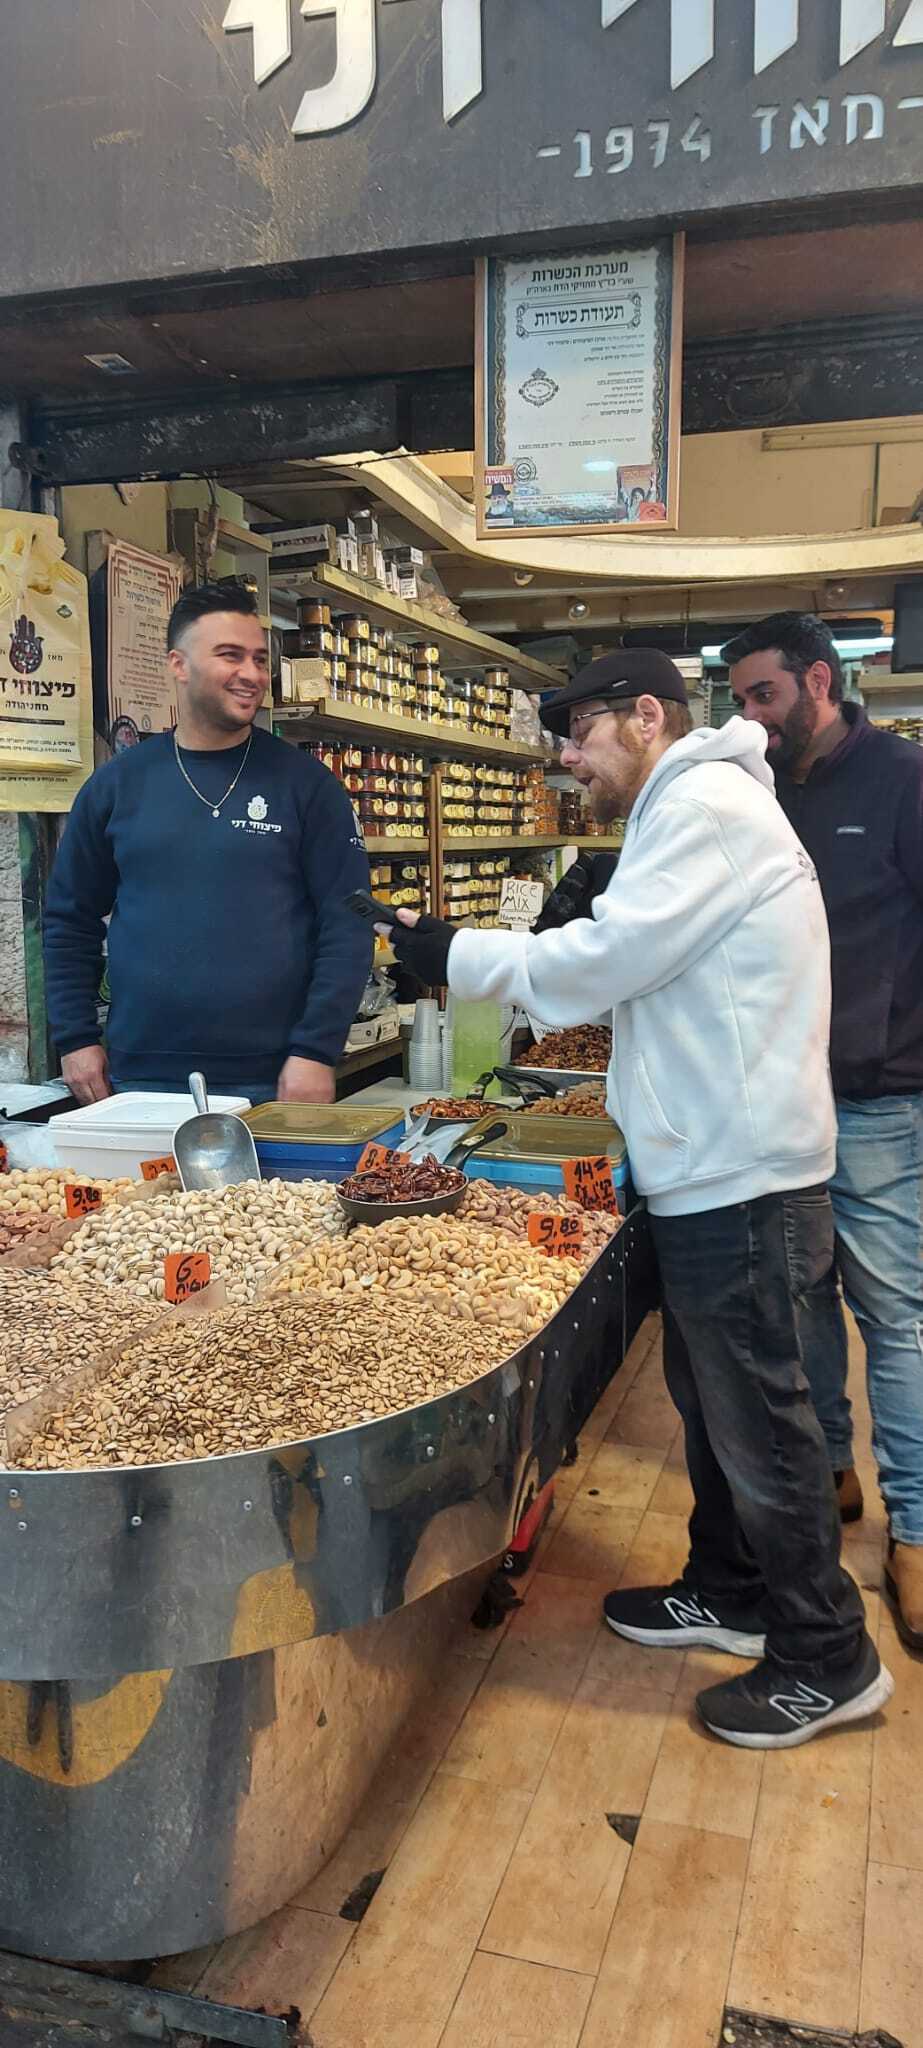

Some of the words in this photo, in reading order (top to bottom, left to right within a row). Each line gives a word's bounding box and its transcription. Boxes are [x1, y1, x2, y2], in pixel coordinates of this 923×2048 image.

[532, 266, 581, 282] הכשרות
[585, 261, 629, 277] מערכת
[534, 309, 578, 327] כשרות
[580, 305, 624, 323] תעודת
[12, 679, 76, 698] פיצוחי
[231, 820, 247, 829] דני
[249, 821, 282, 833] פיצוחי
[501, 896, 530, 912] MIX
